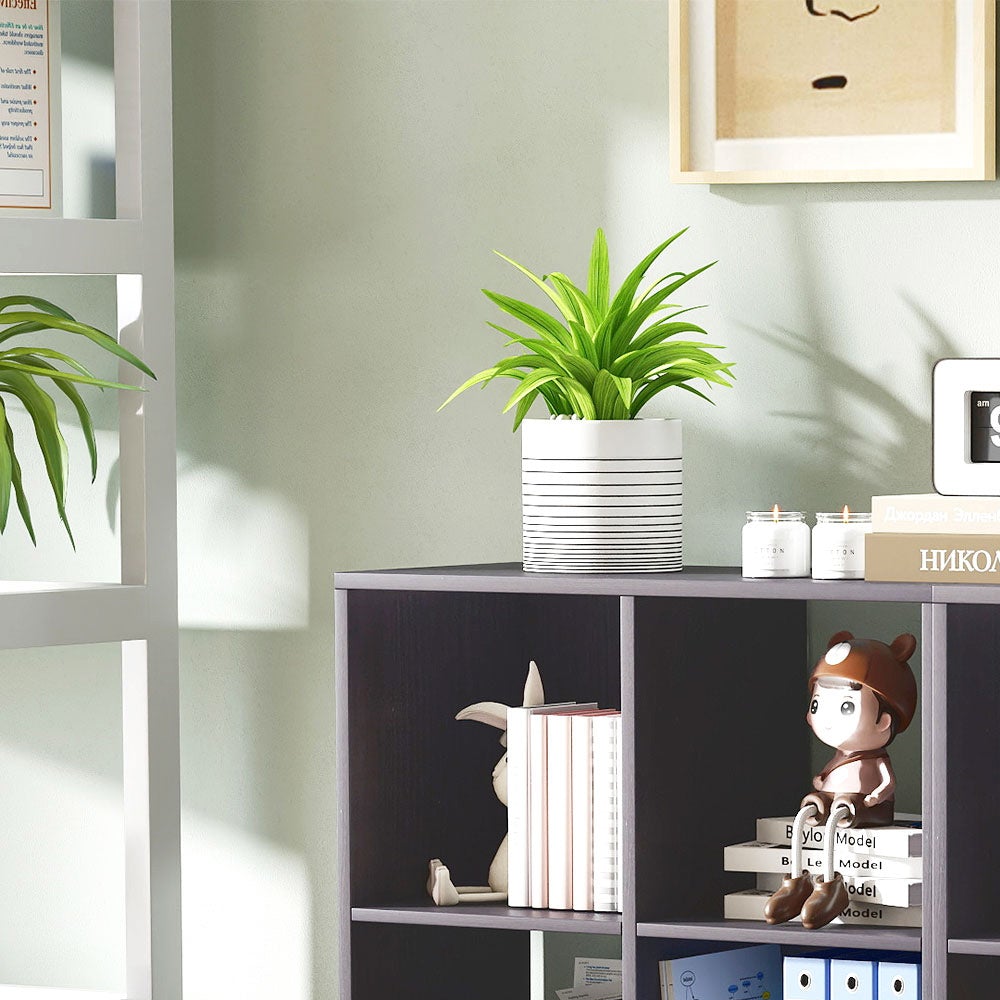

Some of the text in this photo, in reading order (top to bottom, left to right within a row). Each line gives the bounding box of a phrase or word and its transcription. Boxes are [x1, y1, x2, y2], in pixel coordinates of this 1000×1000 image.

[977, 400, 990, 408] am
[884, 506, 949, 526] Джордан
[786, 825, 876, 848] Bylo Model
[839, 859, 882, 870] Model
[844, 882, 876, 897] odel
